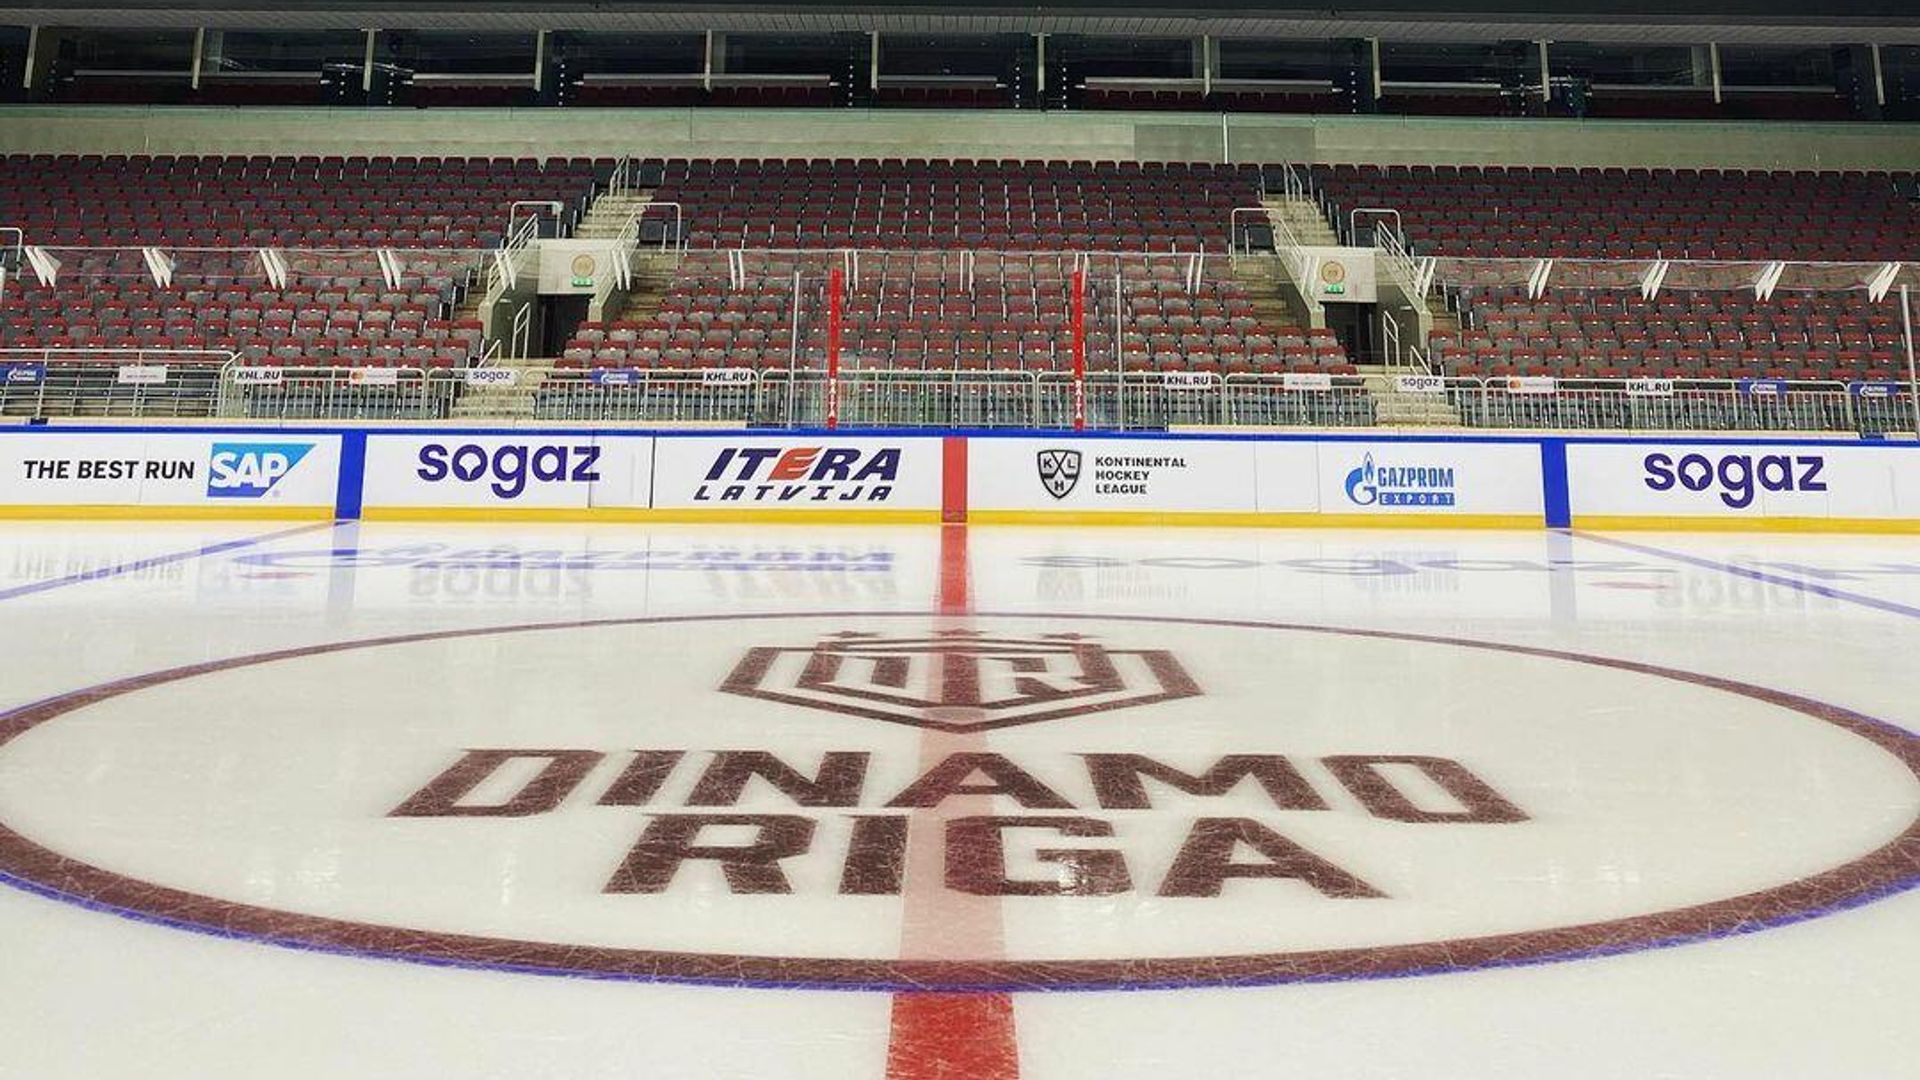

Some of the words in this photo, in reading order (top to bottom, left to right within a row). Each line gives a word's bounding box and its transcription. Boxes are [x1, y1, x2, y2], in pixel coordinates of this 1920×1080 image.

[237, 371, 280, 380] KHL.RU
[705, 372, 748, 382] KHL.RU
[1166, 376, 1209, 386] KHL.RU
[1401, 377, 1439, 390] sogaz
[1628, 382, 1671, 392] KHL.RU
[704, 447, 901, 481] ITERA
[1095, 456, 1186, 468] KONTINENTAL
[24, 461, 70, 479] THE
[77, 461, 139, 479] BEST
[145, 461, 195, 479] RUN
[210, 451, 288, 488] SAP
[418, 444, 600, 498] sogaz
[1095, 470, 1150, 481] HOCKEY
[1377, 467, 1454, 488] GAZPROM
[1644, 453, 1827, 509] sogaz
[694, 485, 892, 501] LATVIJA
[1095, 483, 1147, 495] LEAGUE
[1381, 493, 1452, 504] EXPORT
[388, 749, 1531, 824] DINAMO
[604, 813, 1391, 899] RIGA
